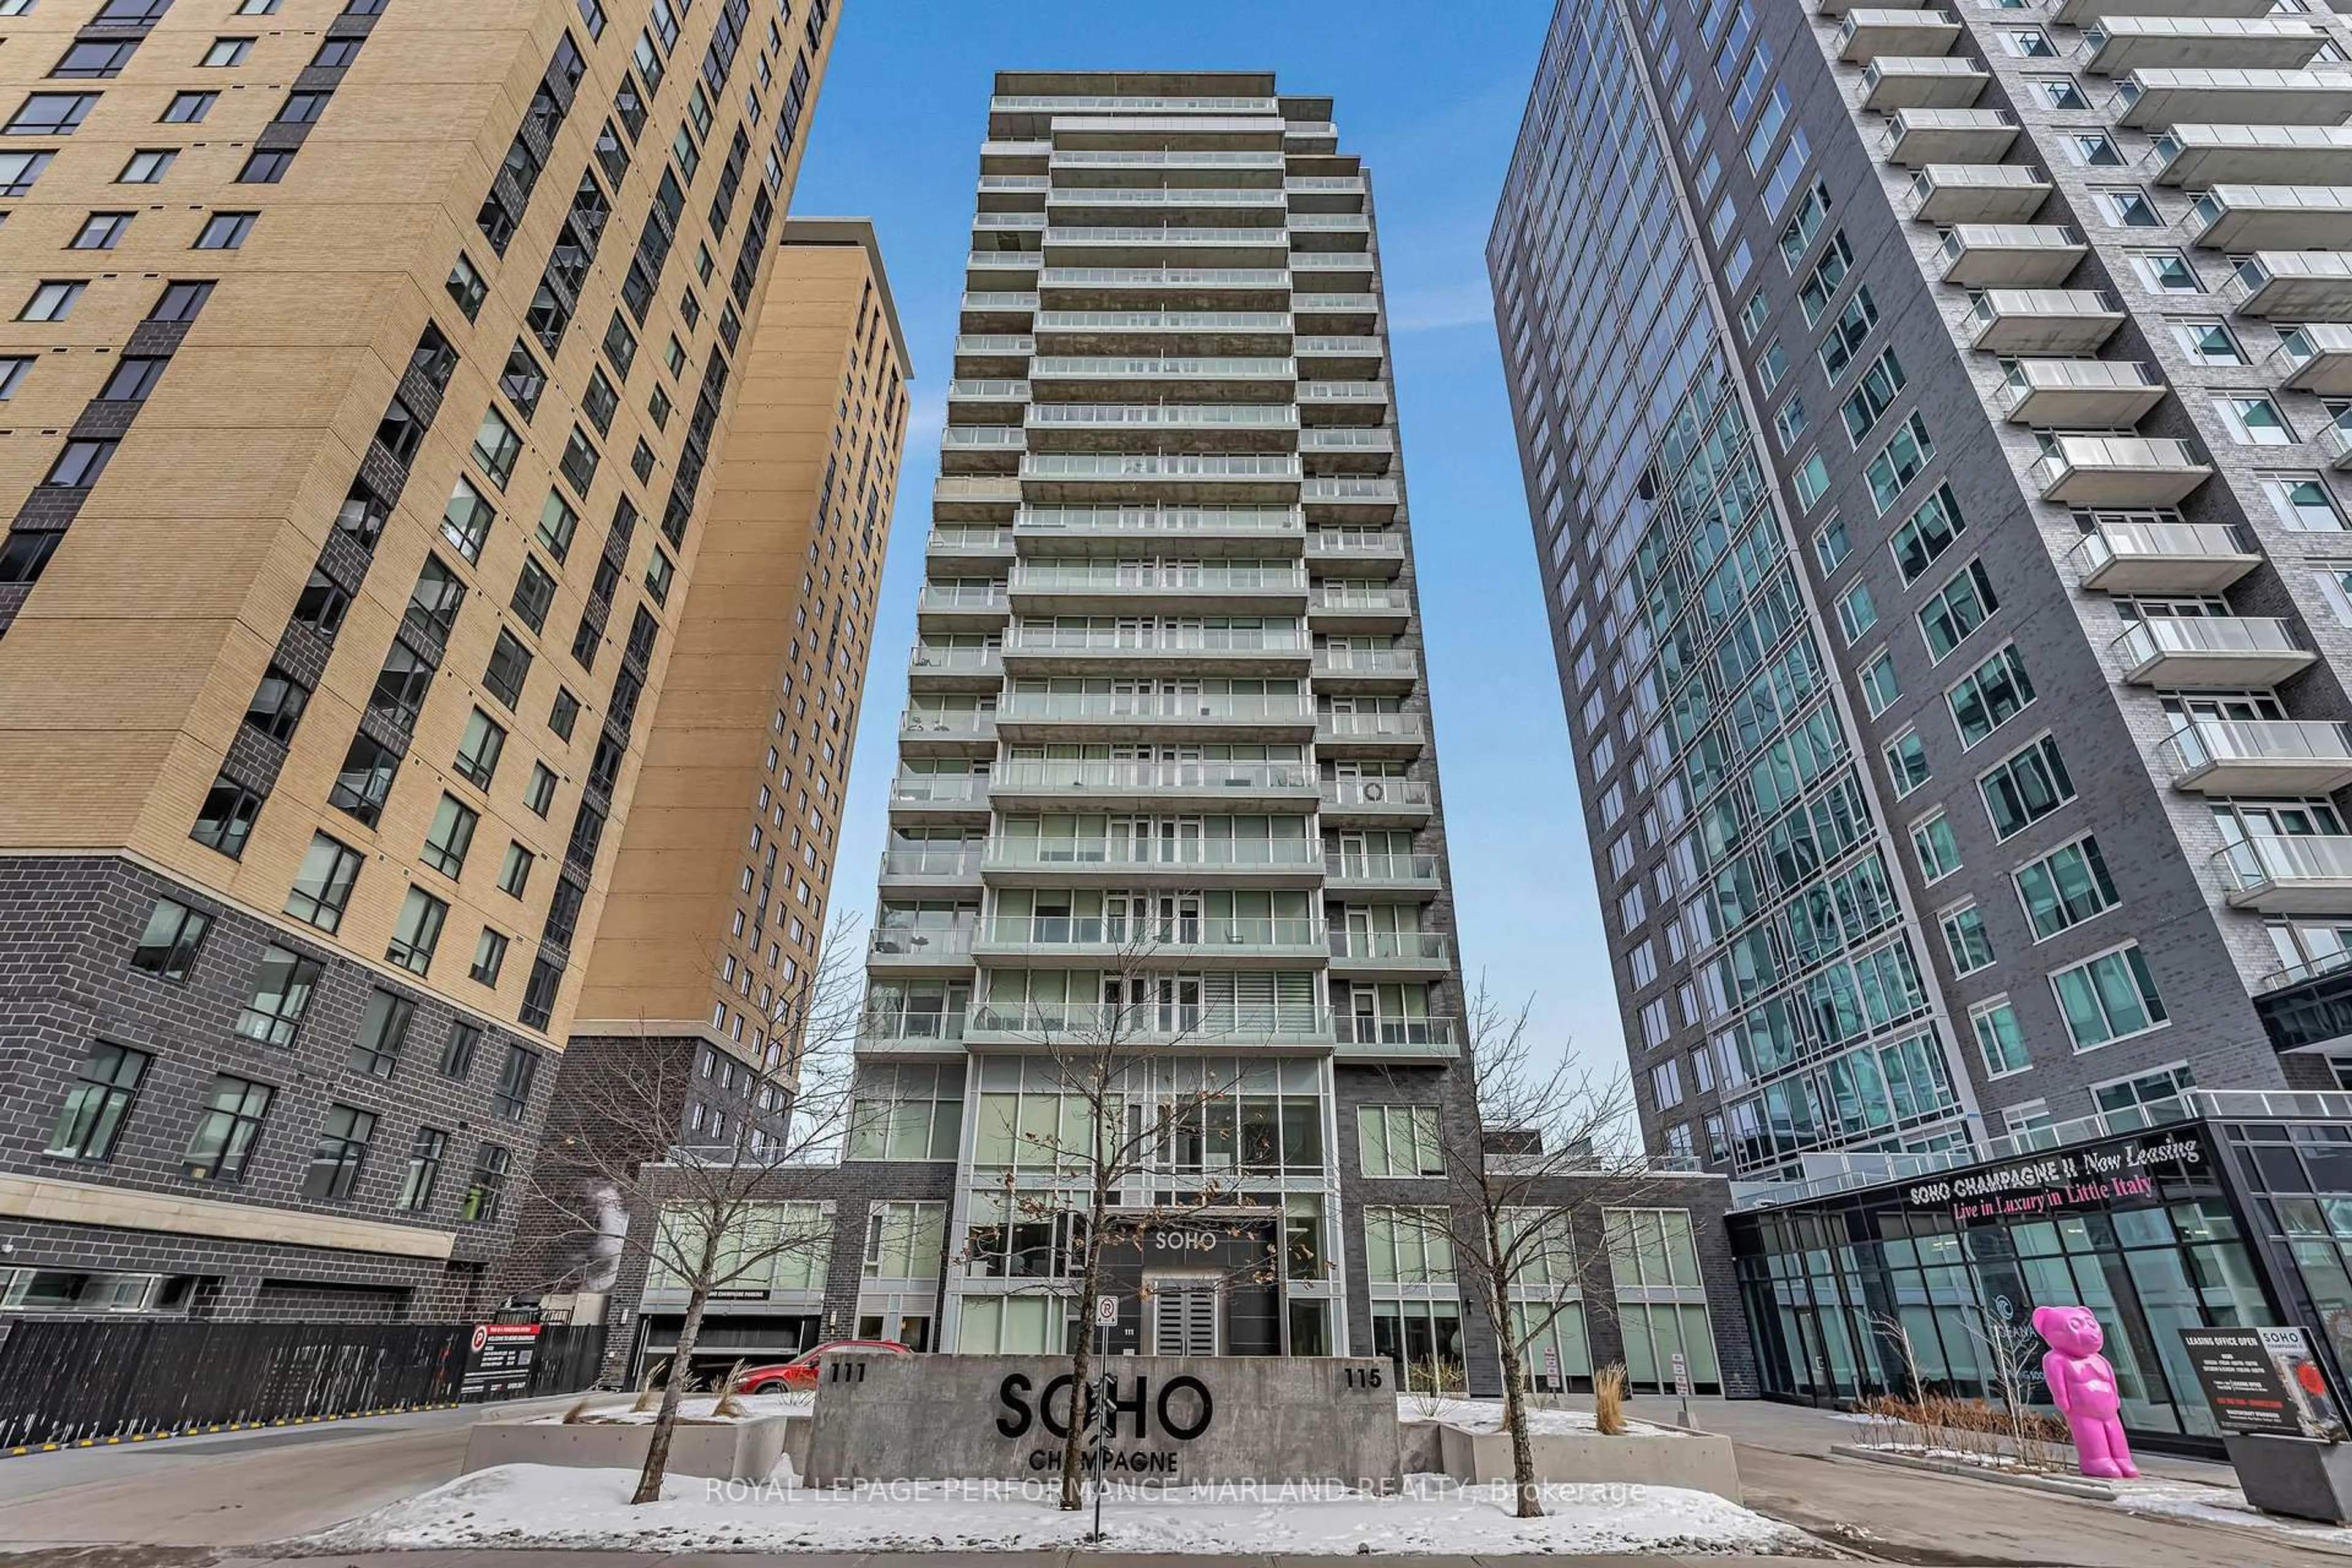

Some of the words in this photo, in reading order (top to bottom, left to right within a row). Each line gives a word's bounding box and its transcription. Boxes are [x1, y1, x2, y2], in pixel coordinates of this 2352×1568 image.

[1910, 1185, 1951, 1205] SOHO
[1953, 1162, 2059, 1198] CHAMPAGNE
[2082, 1152, 2120, 1175] Now
[2125, 1137, 2200, 1167] Leasing
[1953, 1202, 1978, 1219] Live
[1980, 1199, 1994, 1216] in
[1996, 1194, 2045, 1215] Luxury
[2047, 1189, 2062, 1206] in
[2066, 1182, 2108, 1204] Little
[2113, 1174, 2153, 1199] Italy
[1156, 1231, 1216, 1250] SOHO
[2185, 1337, 2214, 1346] LEASING
[2215, 1337, 2238, 1346] OFFICE
[2238, 1337, 2259, 1346] OPEN
[2263, 1332, 2298, 1343] SOHO
[832, 1363, 865, 1382] 111
[1344, 1368, 1382, 1389] 115
[996, 1373, 1213, 1440] SOHO
[1029, 1449, 1177, 1472] CHMPAGNE
